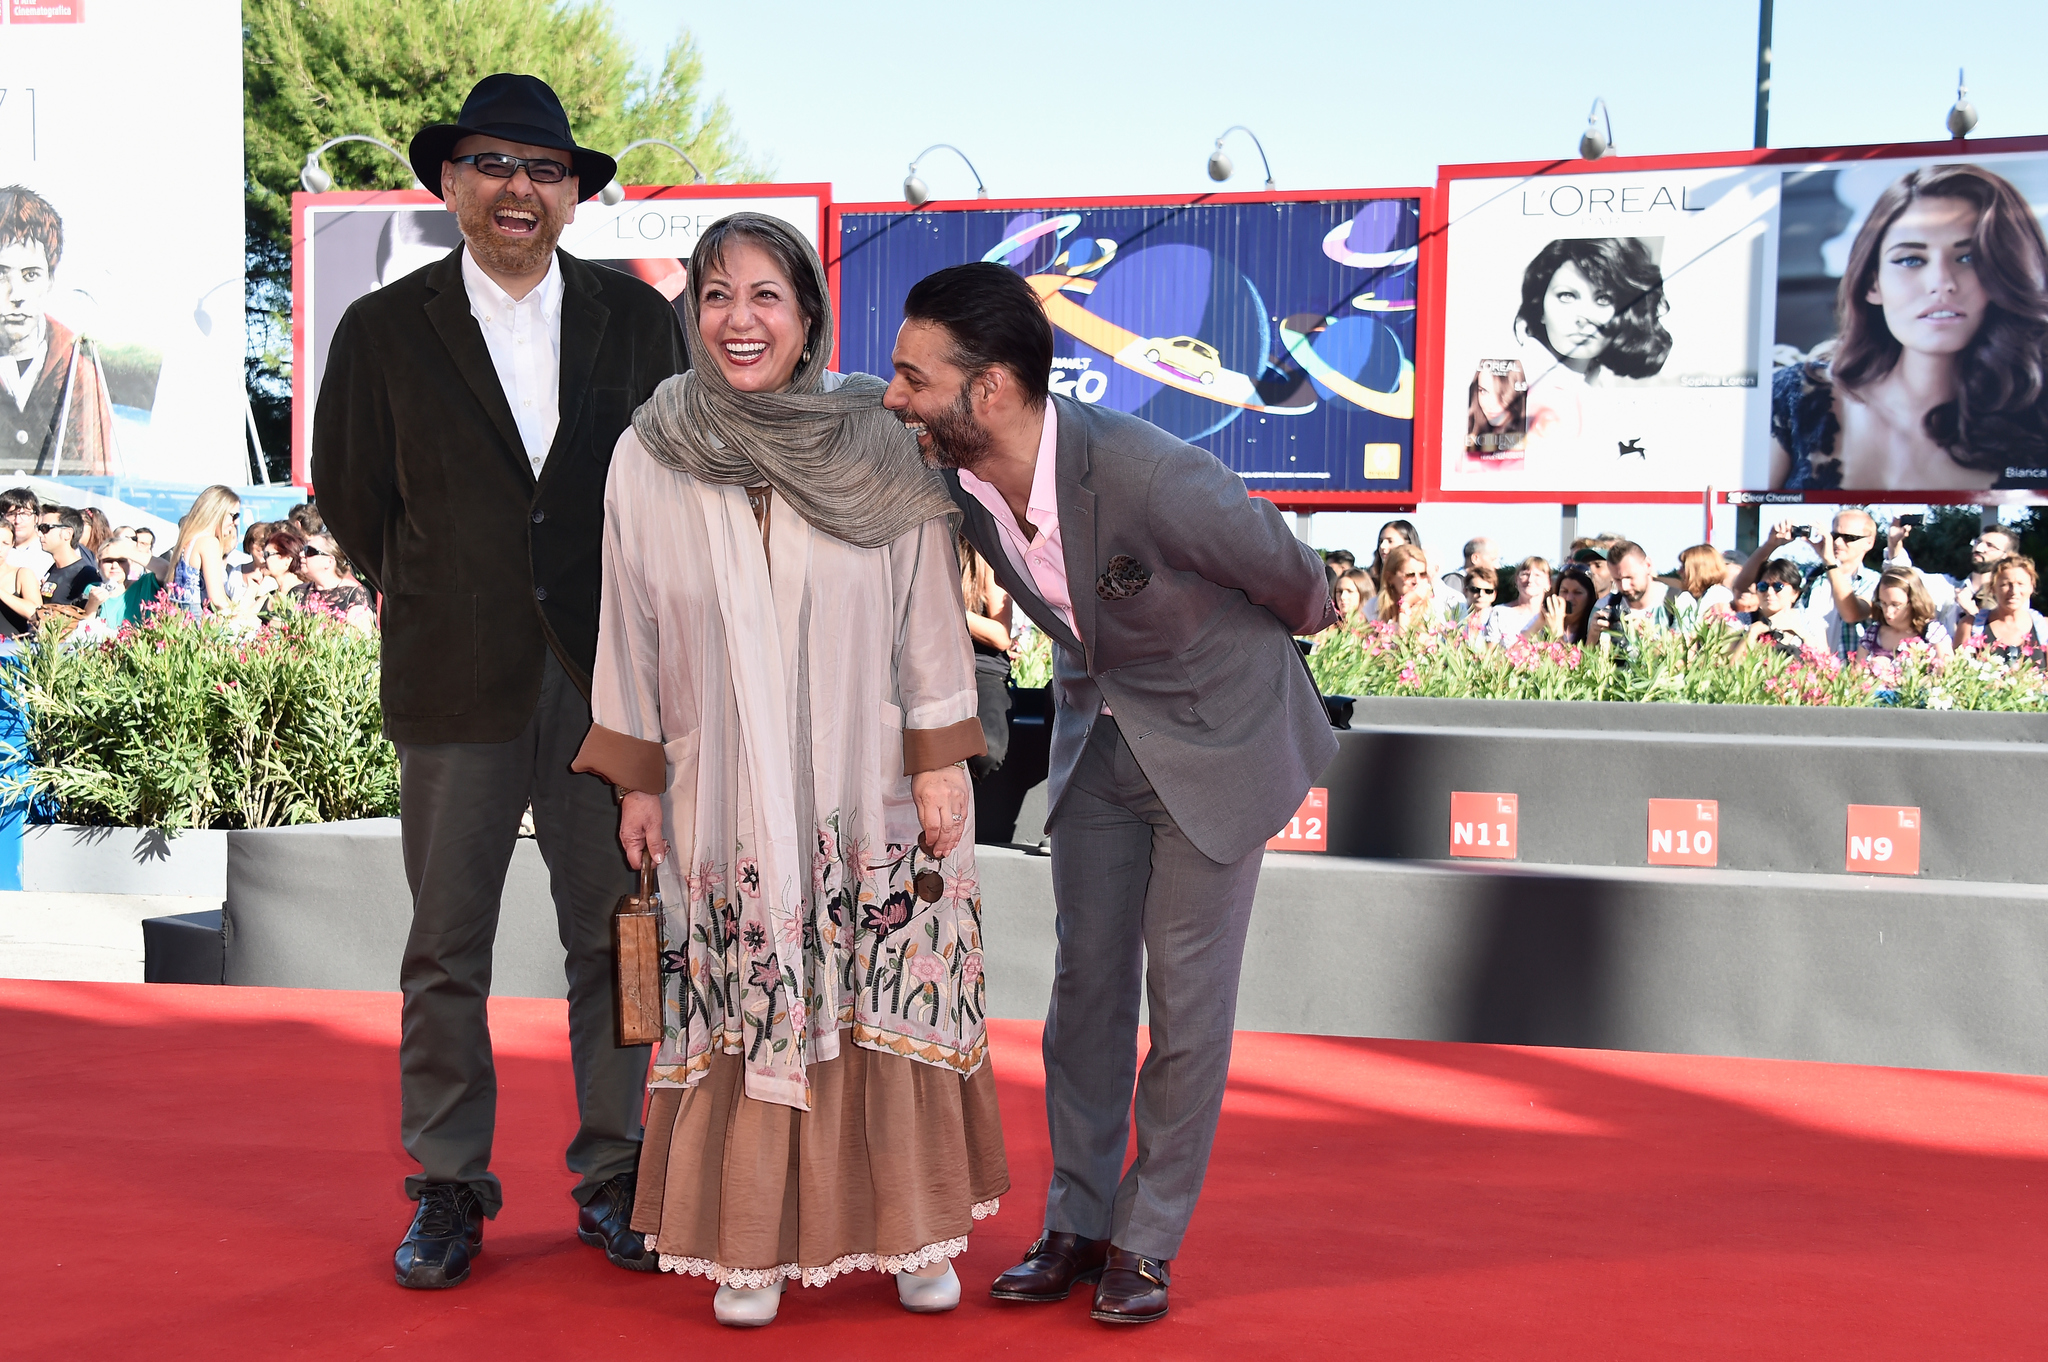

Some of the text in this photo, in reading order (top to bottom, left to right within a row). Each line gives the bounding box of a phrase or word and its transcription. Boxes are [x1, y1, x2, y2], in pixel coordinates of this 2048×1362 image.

[14, 5, 72, 18] Cinematografica
[0, 88, 36, 161] 1
[1680, 376, 1755, 388] Sophia Loren
[2004, 466, 2048, 479] Bianca
[1741, 491, 1803, 503] Clear Channel
[1453, 821, 1510, 847] N11
[1651, 829, 1713, 855] N10
[1850, 835, 1894, 862] N9
